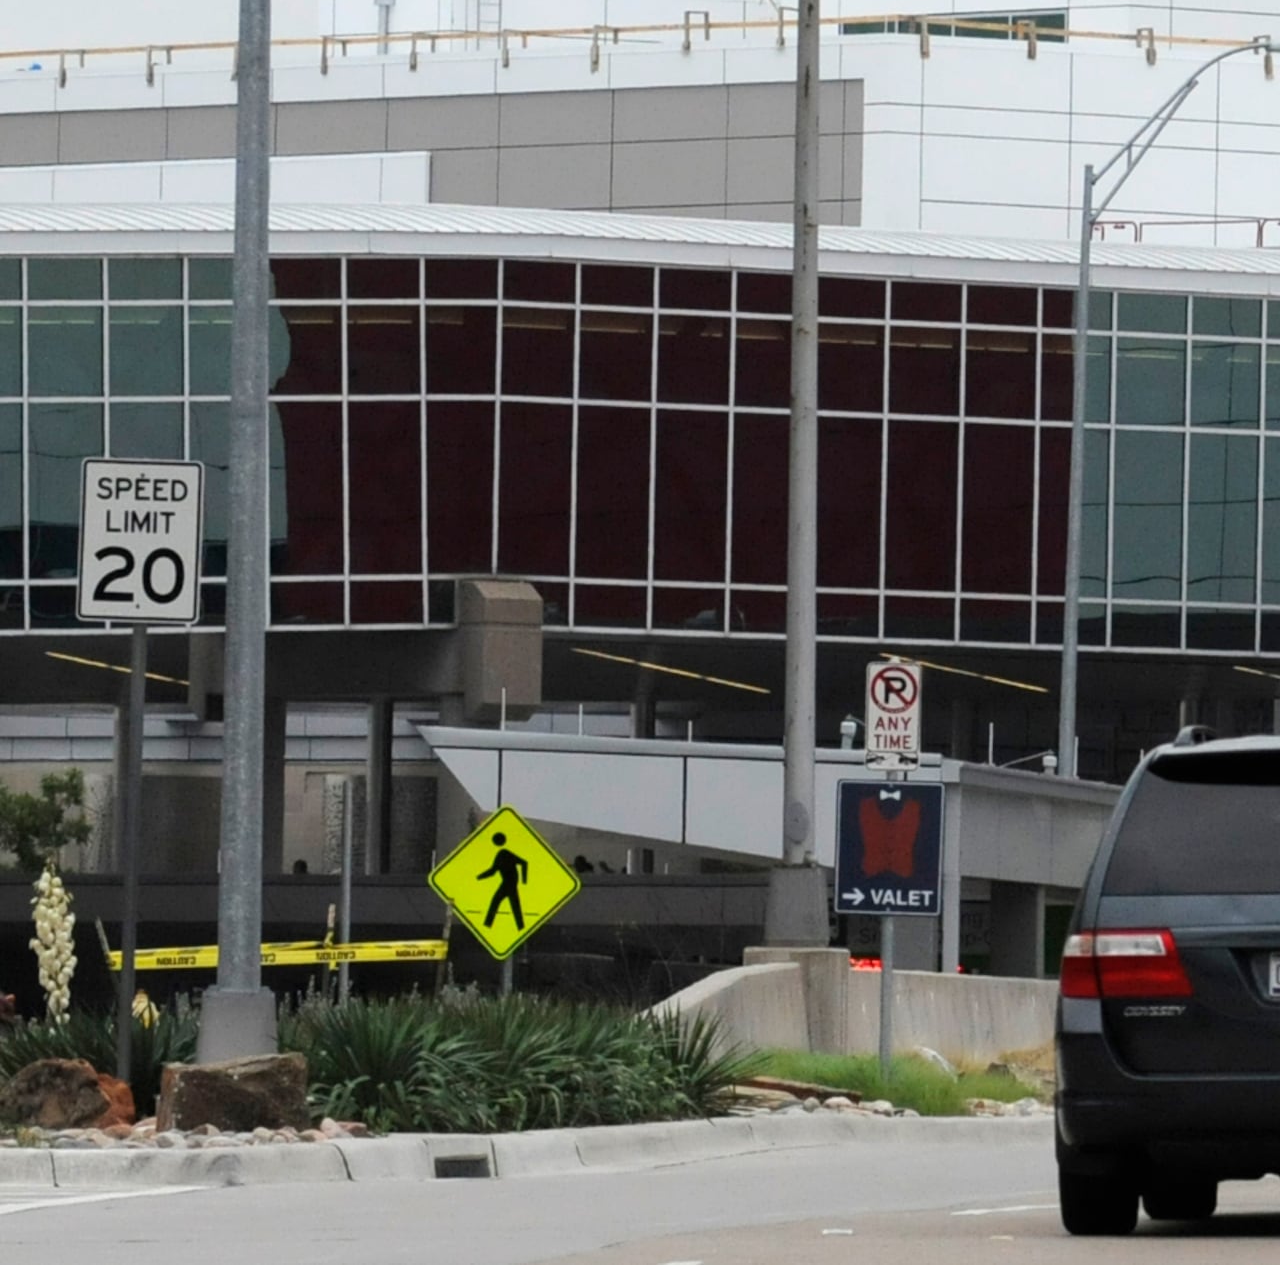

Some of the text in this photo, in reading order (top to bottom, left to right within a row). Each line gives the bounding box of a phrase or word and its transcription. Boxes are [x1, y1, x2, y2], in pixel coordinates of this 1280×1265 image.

[96, 477, 189, 502] SPEED
[105, 510, 175, 534] LIMIT
[92, 546, 185, 604] 20
[875, 716, 912, 731] ANY
[874, 734, 912, 749] TIME
[870, 888, 934, 908] VALET
[156, 955, 197, 966] CAUTION
[315, 949, 357, 961] CAUTION
